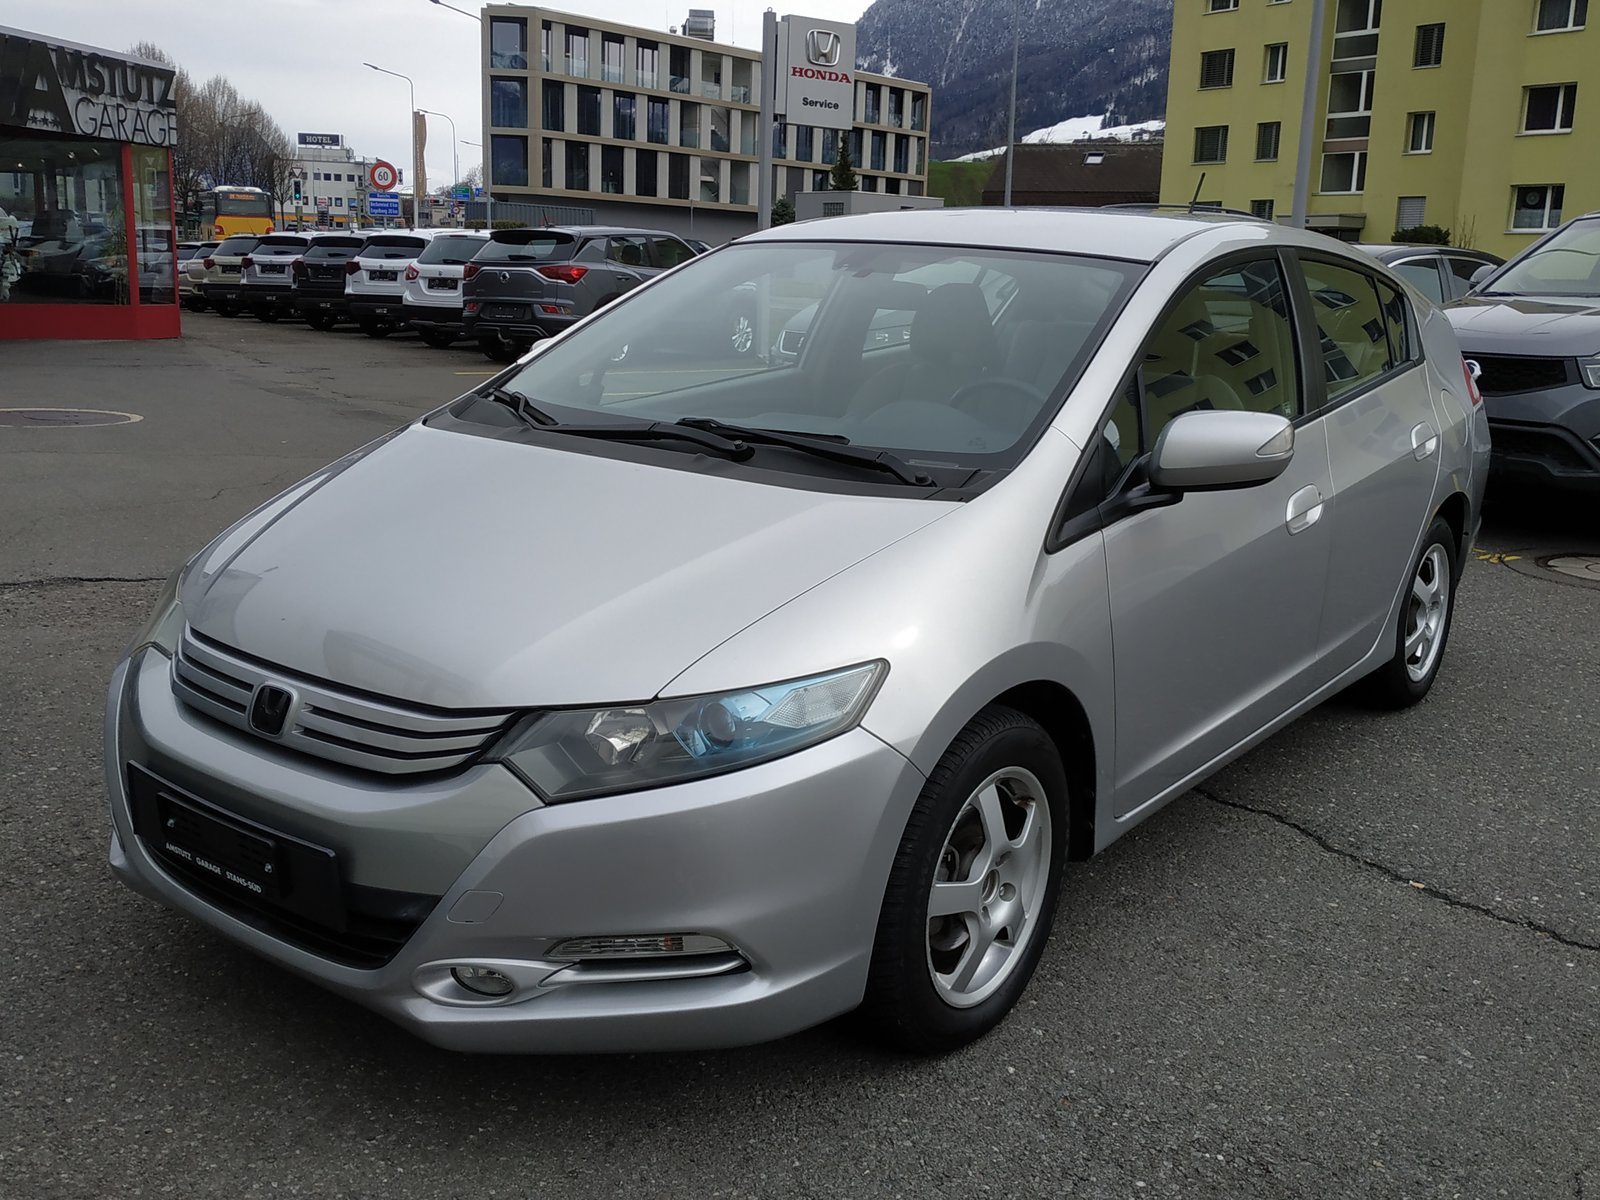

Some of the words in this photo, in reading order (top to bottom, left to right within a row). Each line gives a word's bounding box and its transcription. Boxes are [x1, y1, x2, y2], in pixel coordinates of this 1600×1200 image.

[791, 67, 851, 83] HONDA
[14, 42, 176, 133] AMSTUTZ
[802, 97, 839, 110] Service
[75, 96, 177, 147] GARAGE
[305, 135, 332, 144] HOTEL
[378, 171, 388, 181] 60
[165, 842, 192, 861] AMSTUTZ
[195, 857, 222, 875] GARAGE
